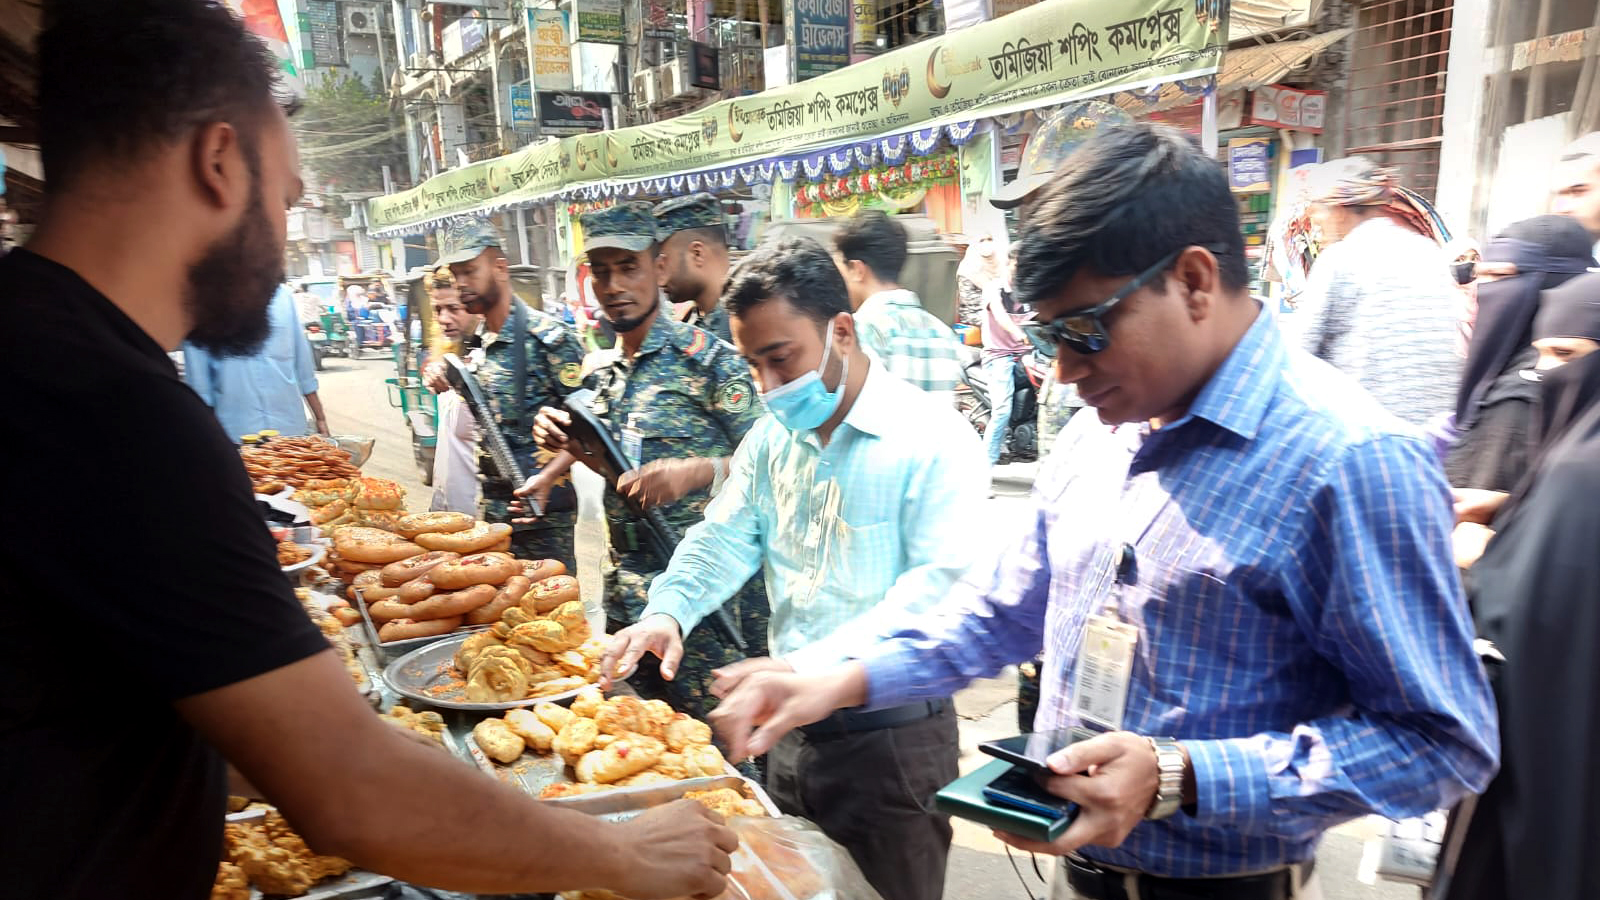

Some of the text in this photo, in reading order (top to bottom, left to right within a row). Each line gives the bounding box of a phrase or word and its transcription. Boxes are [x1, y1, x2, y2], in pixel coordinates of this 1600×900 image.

[801, 18, 846, 49] ট্রাভেলস
[988, 8, 1184, 82] তমিজিয়া শপিং কমপ্লেক্স
[766, 86, 879, 132] তমিজিয়া শপিং কমপ্লেক্স
